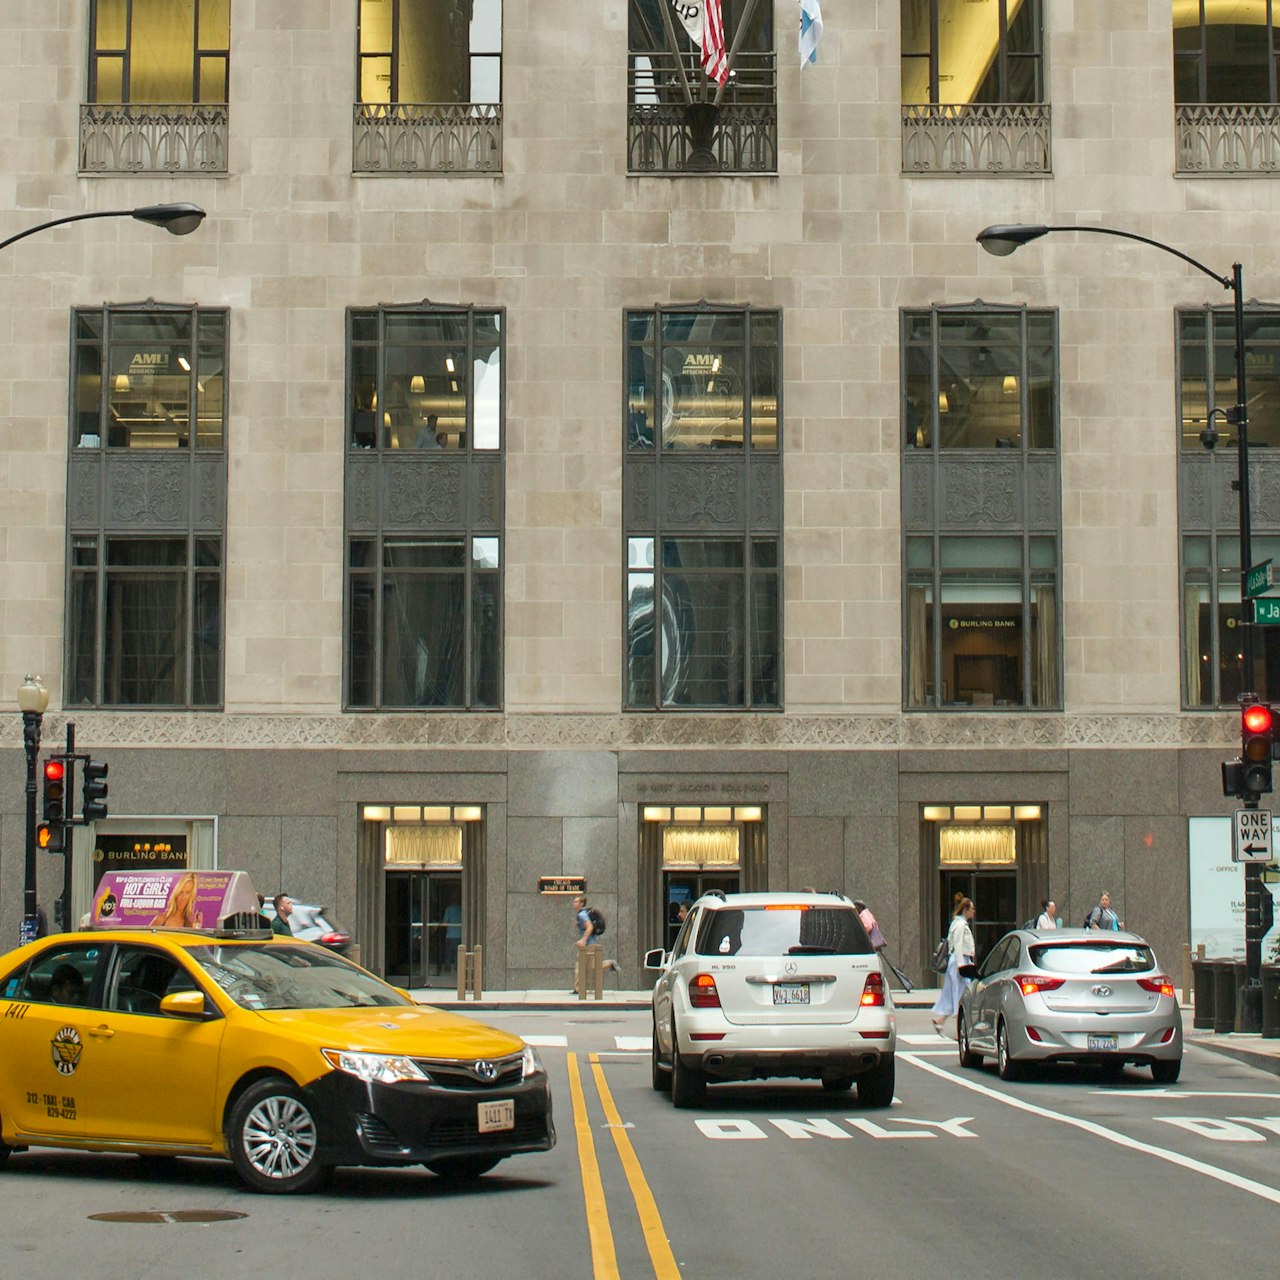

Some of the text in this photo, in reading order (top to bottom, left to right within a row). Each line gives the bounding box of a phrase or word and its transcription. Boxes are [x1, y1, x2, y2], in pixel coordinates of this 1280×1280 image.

[132, 353, 169, 364] AMLI
[685, 354, 722, 365] AMLI
[1259, 606, 1265, 616] W
[1241, 814, 1268, 826] ONE
[1241, 828, 1268, 841] WAY
[108, 851, 156, 860] BURLING
[123, 883, 171, 895] HOT GIRLS
[4, 1003, 30, 1019] 1411
[56, 1027, 80, 1043] YELLOW
[58, 1061, 74, 1073] CAB
[26, 1092, 76, 1108] 312 TAXI CAB
[694, 1117, 980, 1139] ONLY
